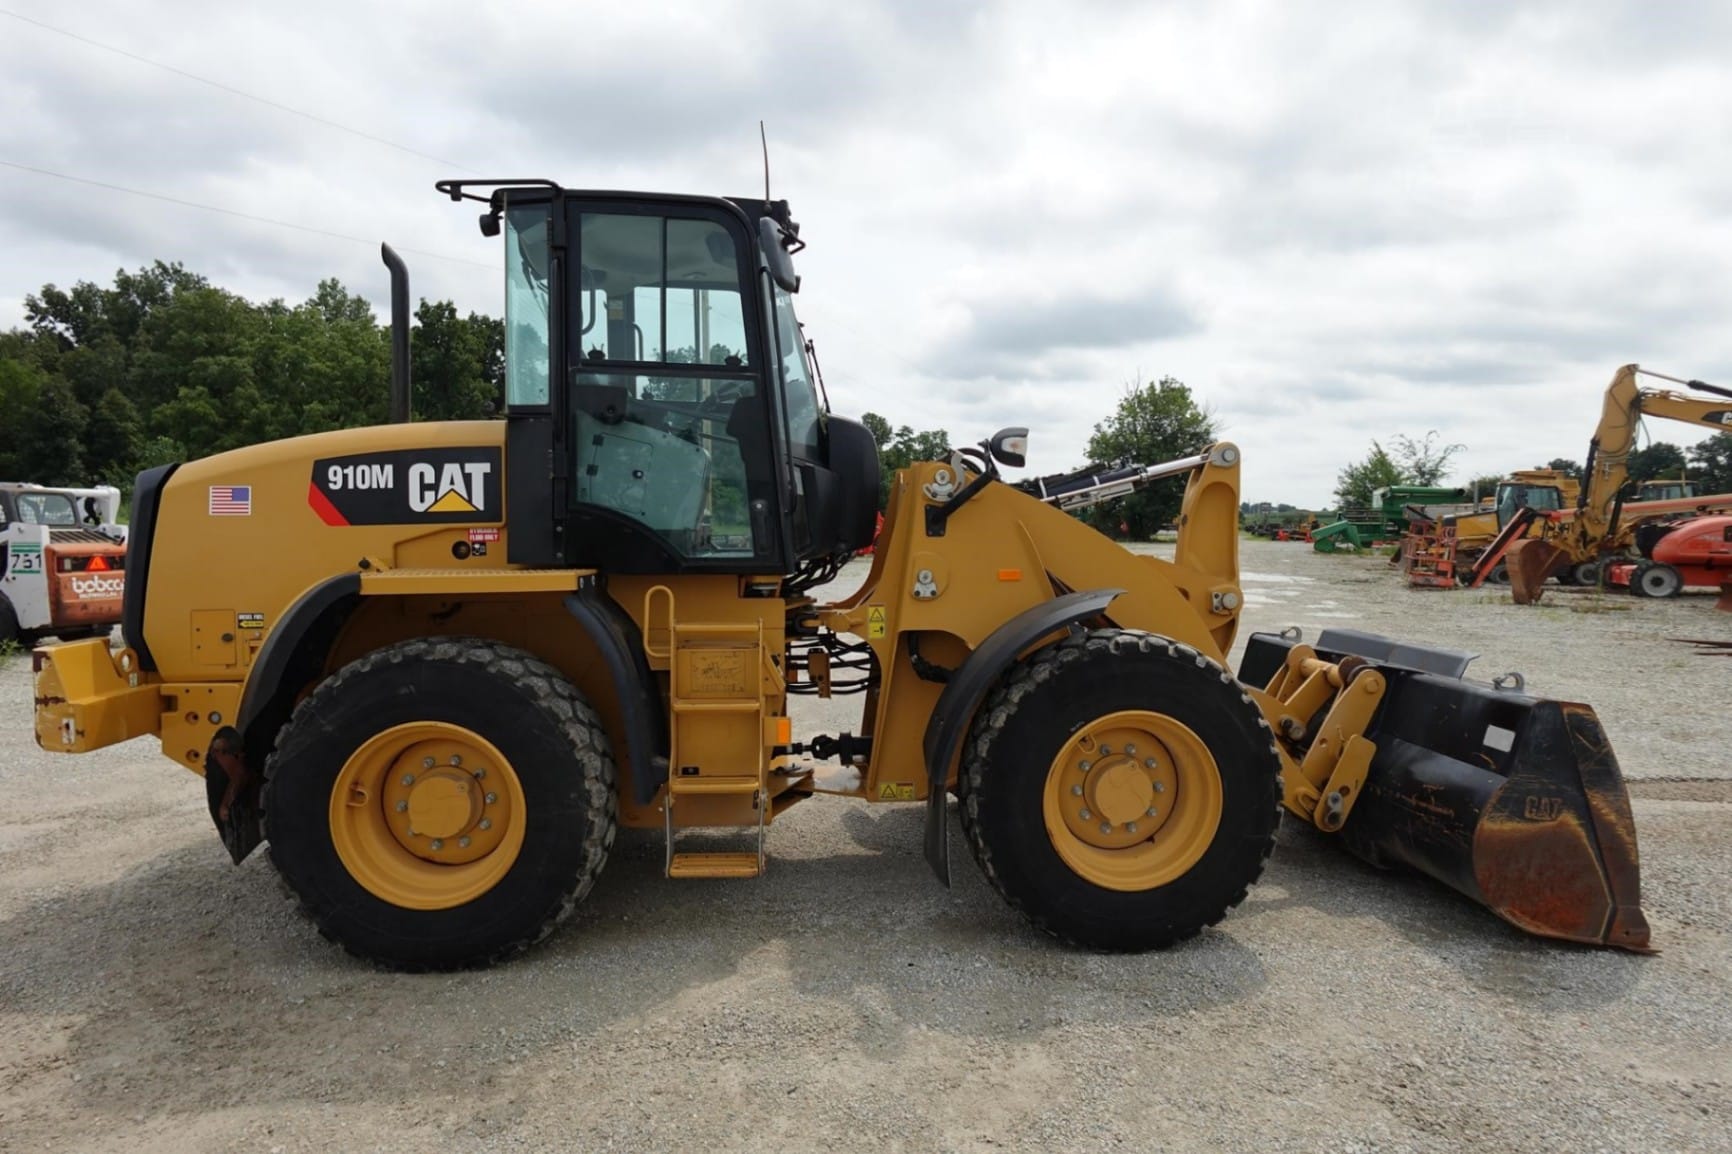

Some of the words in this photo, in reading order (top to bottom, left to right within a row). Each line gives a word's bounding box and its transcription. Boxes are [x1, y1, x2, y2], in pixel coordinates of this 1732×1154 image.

[328, 464, 393, 490] 910M
[408, 462, 491, 512] CAT
[11, 554, 42, 569] 751
[71, 575, 124, 593] bobca
[1524, 796, 1563, 820] CAT
